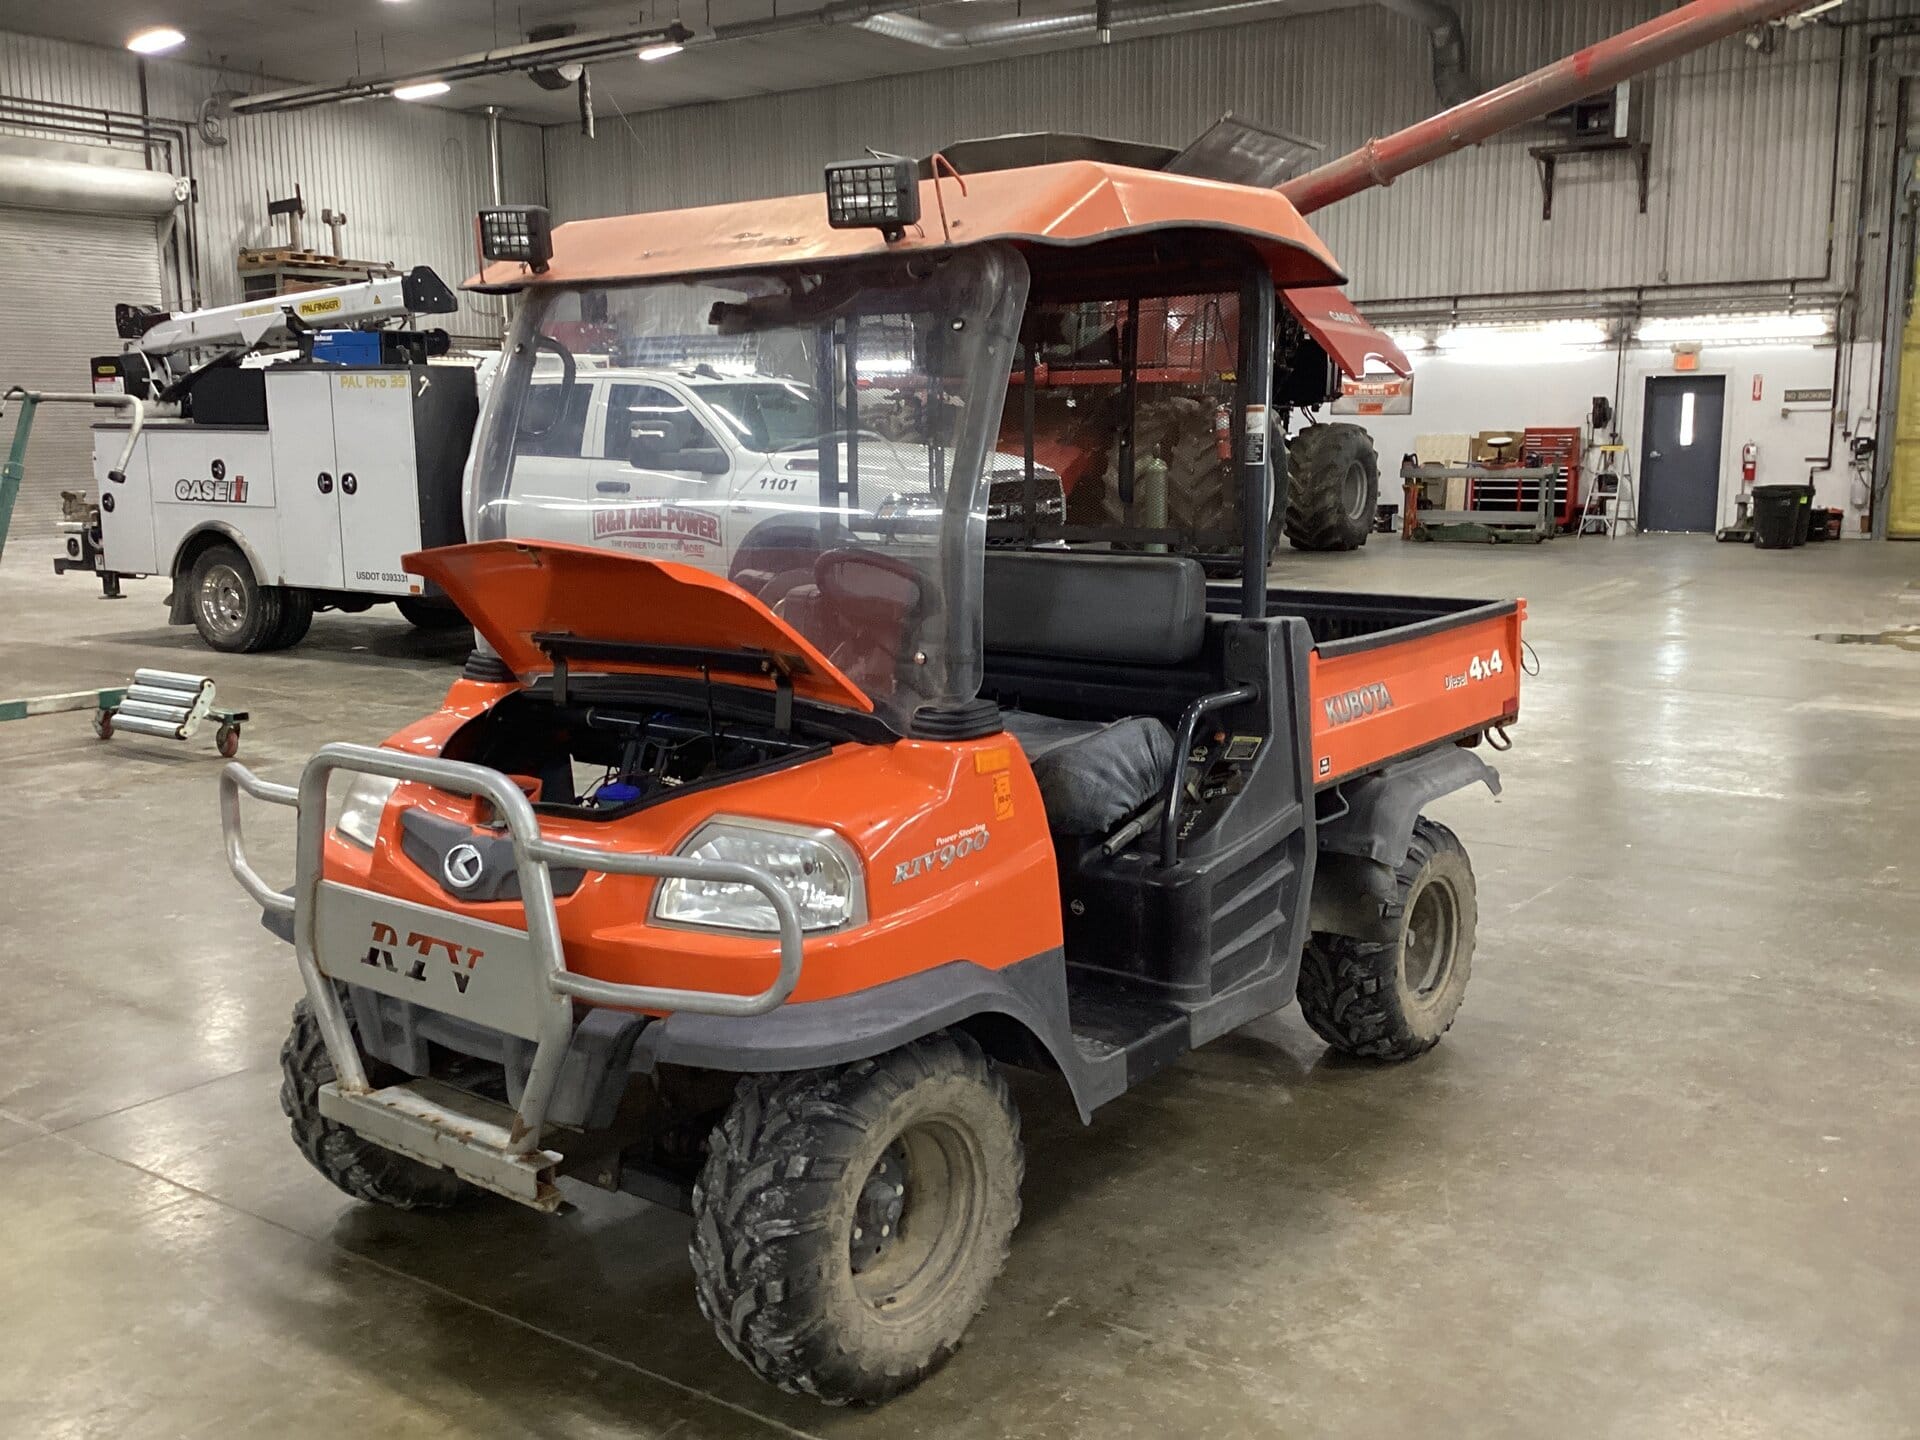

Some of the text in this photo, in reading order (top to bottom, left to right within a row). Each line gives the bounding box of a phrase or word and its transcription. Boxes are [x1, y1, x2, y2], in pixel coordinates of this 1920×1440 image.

[301, 300, 340, 314] PALFINGER
[340, 375, 363, 388] PAL
[367, 375, 387, 388] Pro
[1786, 391, 1797, 400] NO
[175, 479, 229, 502] CASE
[759, 477, 797, 491] 1101
[596, 507, 720, 541] H&R AGRI-POWER
[623, 541, 647, 550] POWER
[648, 542, 656, 550] TO
[683, 544, 705, 553] MORE!
[356, 571, 380, 581] USDOT
[1444, 649, 1504, 691] Diesel 4x4
[1324, 682, 1395, 728] KUBOTA
[936, 823, 986, 846] Power Steering
[892, 830, 990, 885] RTV900
[360, 921, 485, 993] RTV
